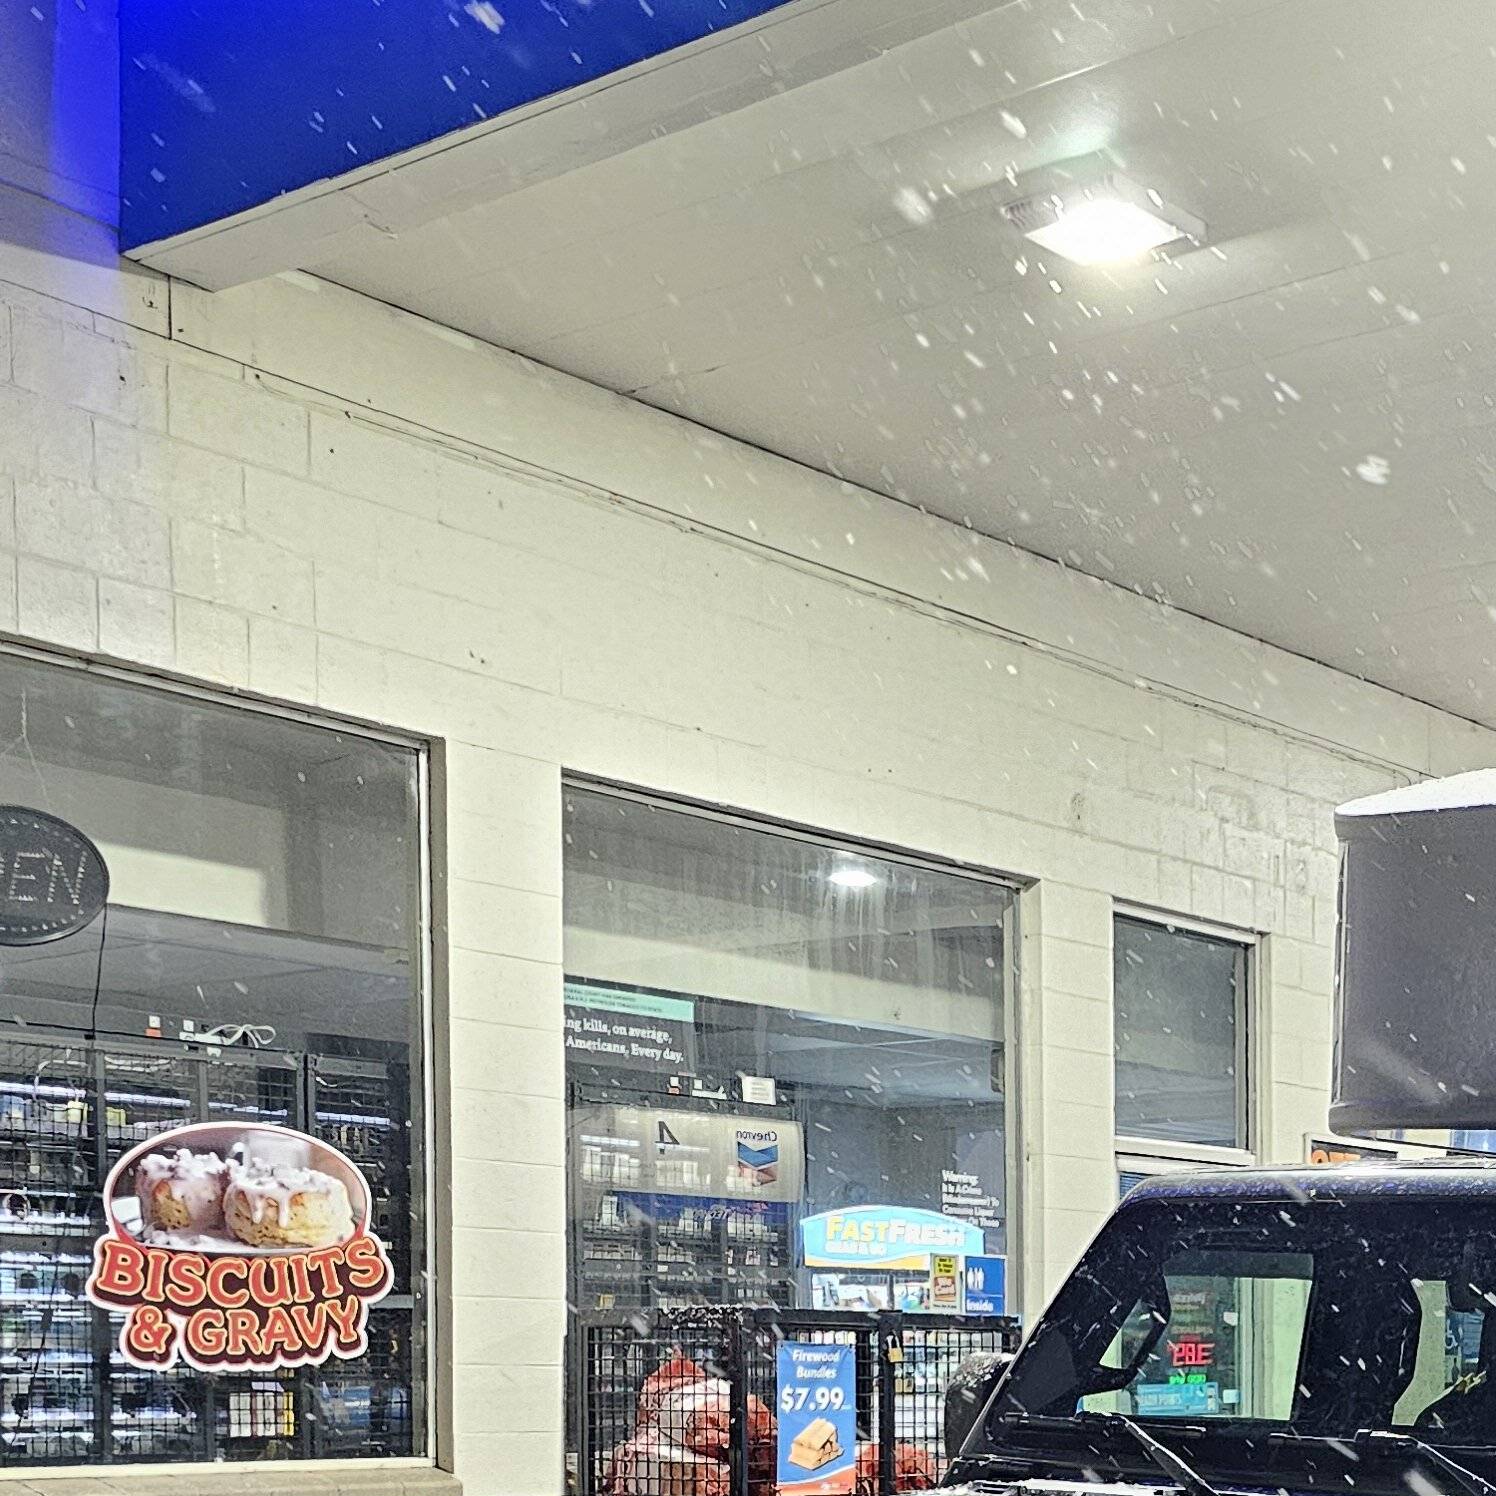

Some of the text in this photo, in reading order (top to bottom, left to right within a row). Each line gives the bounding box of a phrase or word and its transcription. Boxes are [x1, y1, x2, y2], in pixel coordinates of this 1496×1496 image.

[0, 851, 88, 904] EN
[583, 1018, 611, 1036] kills,
[612, 1024, 627, 1036] on
[628, 1025, 673, 1044] average,
[631, 1043, 662, 1061] Every
[663, 1047, 684, 1064] day.
[97, 1237, 384, 1308] BISCUITS
[130, 1295, 359, 1355] & GRAVY
[792, 1350, 841, 1363] Firewood
[796, 1365, 837, 1379] Bundles
[781, 1383, 845, 1414] $7.99
